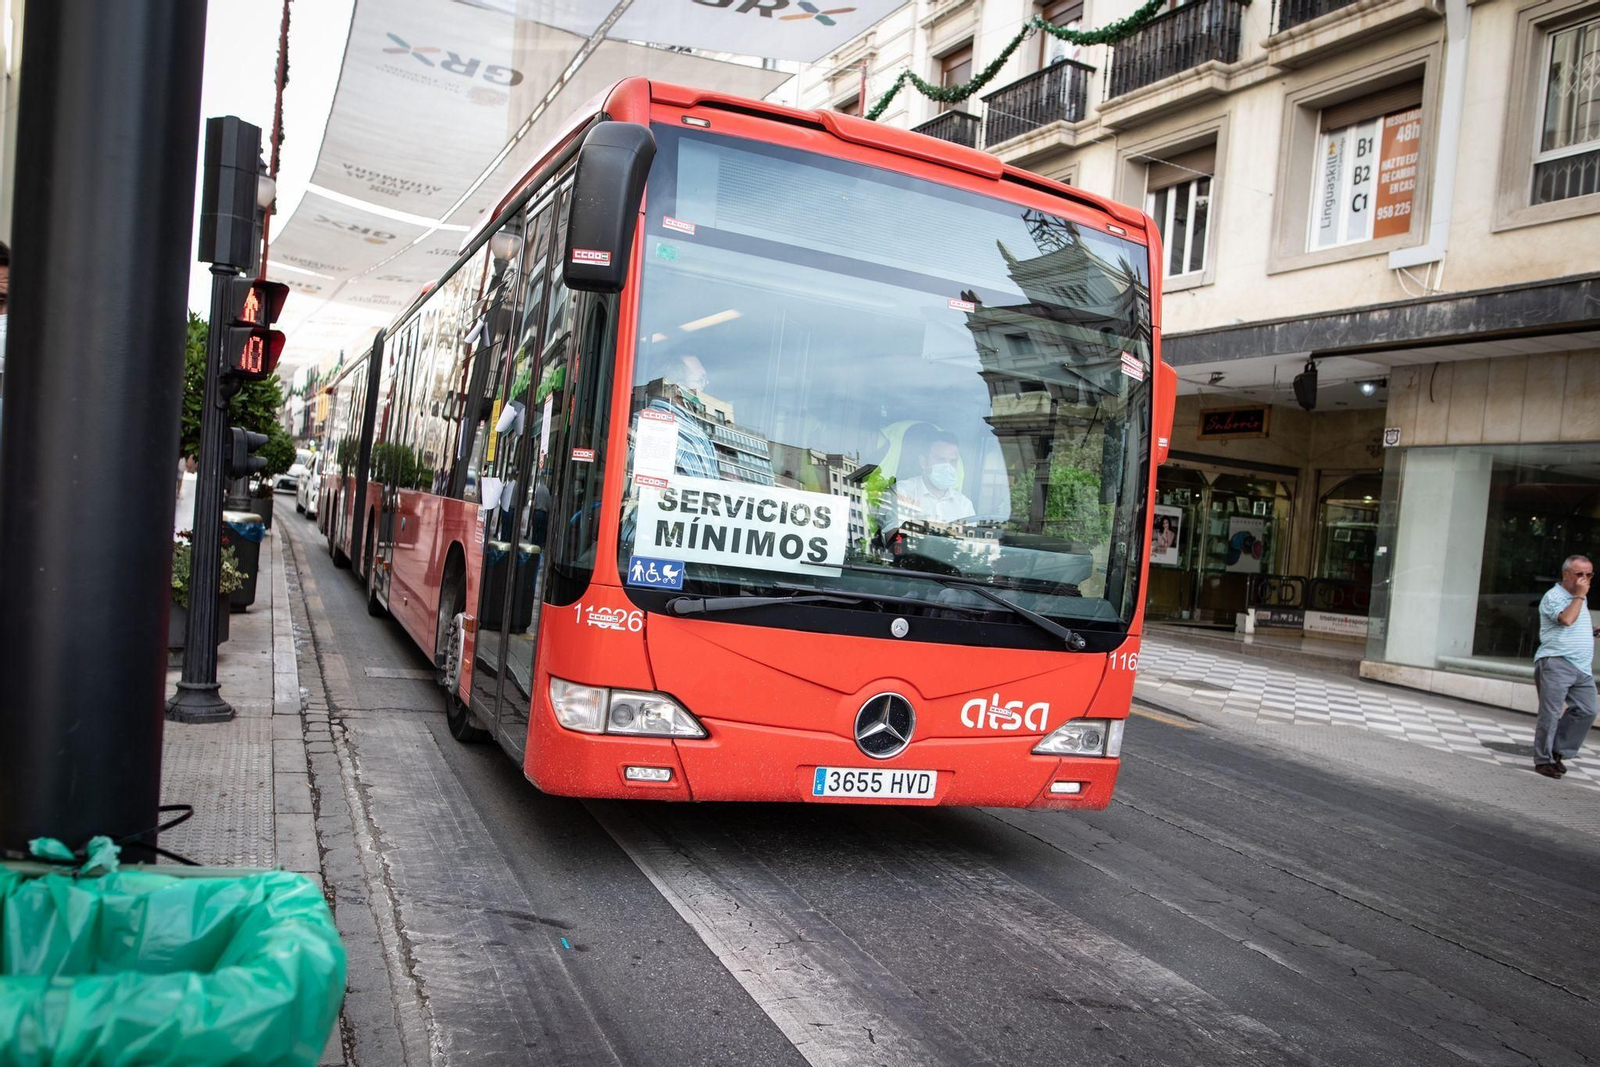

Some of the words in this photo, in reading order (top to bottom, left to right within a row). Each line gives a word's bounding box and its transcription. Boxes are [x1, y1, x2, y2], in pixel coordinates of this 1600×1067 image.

[1396, 123, 1420, 142] 48h
[1357, 138, 1373, 158] B1
[1353, 166, 1370, 185] B2
[1381, 171, 1391, 184] DE
[1321, 155, 1337, 229] Linguaskill
[1389, 182, 1399, 194] EN
[1352, 194, 1368, 213] C1
[1394, 201, 1411, 216] 225
[657, 487, 832, 529] SERVICIOS
[655, 517, 829, 563] MÍNIMOS
[1110, 652, 1138, 670] 116
[828, 771, 883, 793] 3655
[890, 773, 931, 794] HVD
